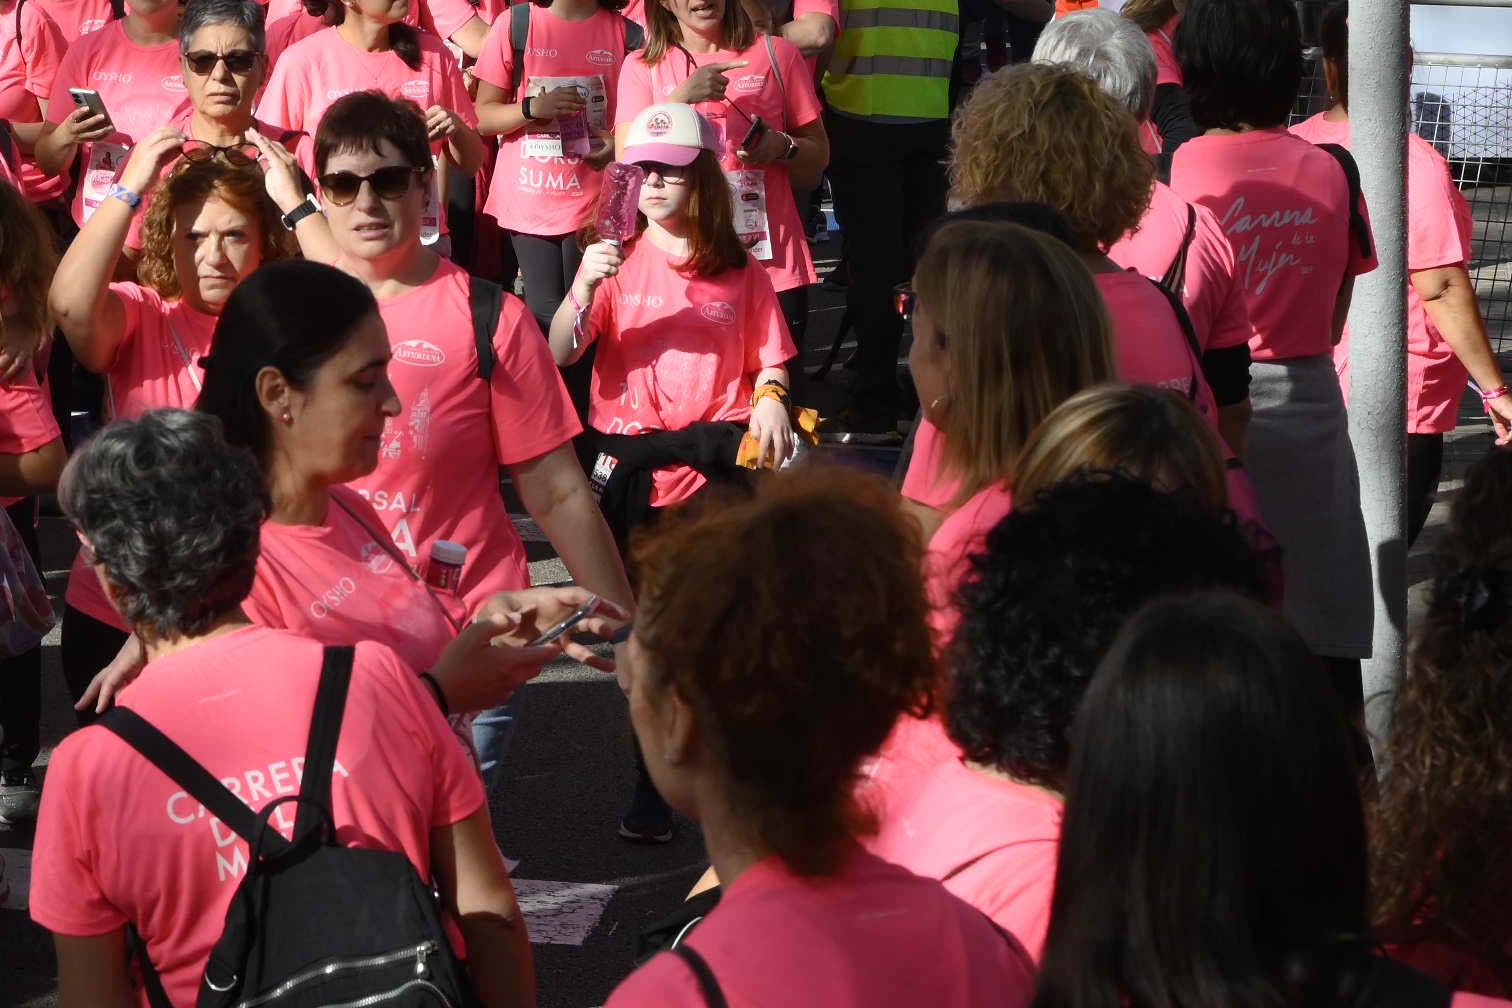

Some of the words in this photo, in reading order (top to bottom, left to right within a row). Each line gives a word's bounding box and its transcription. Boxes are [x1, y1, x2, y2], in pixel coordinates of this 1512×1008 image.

[518, 166, 581, 190] SUMA
[1221, 196, 1319, 236] Carrera
[310, 575, 356, 621] OYSHO
[166, 755, 350, 825] CRRERA
